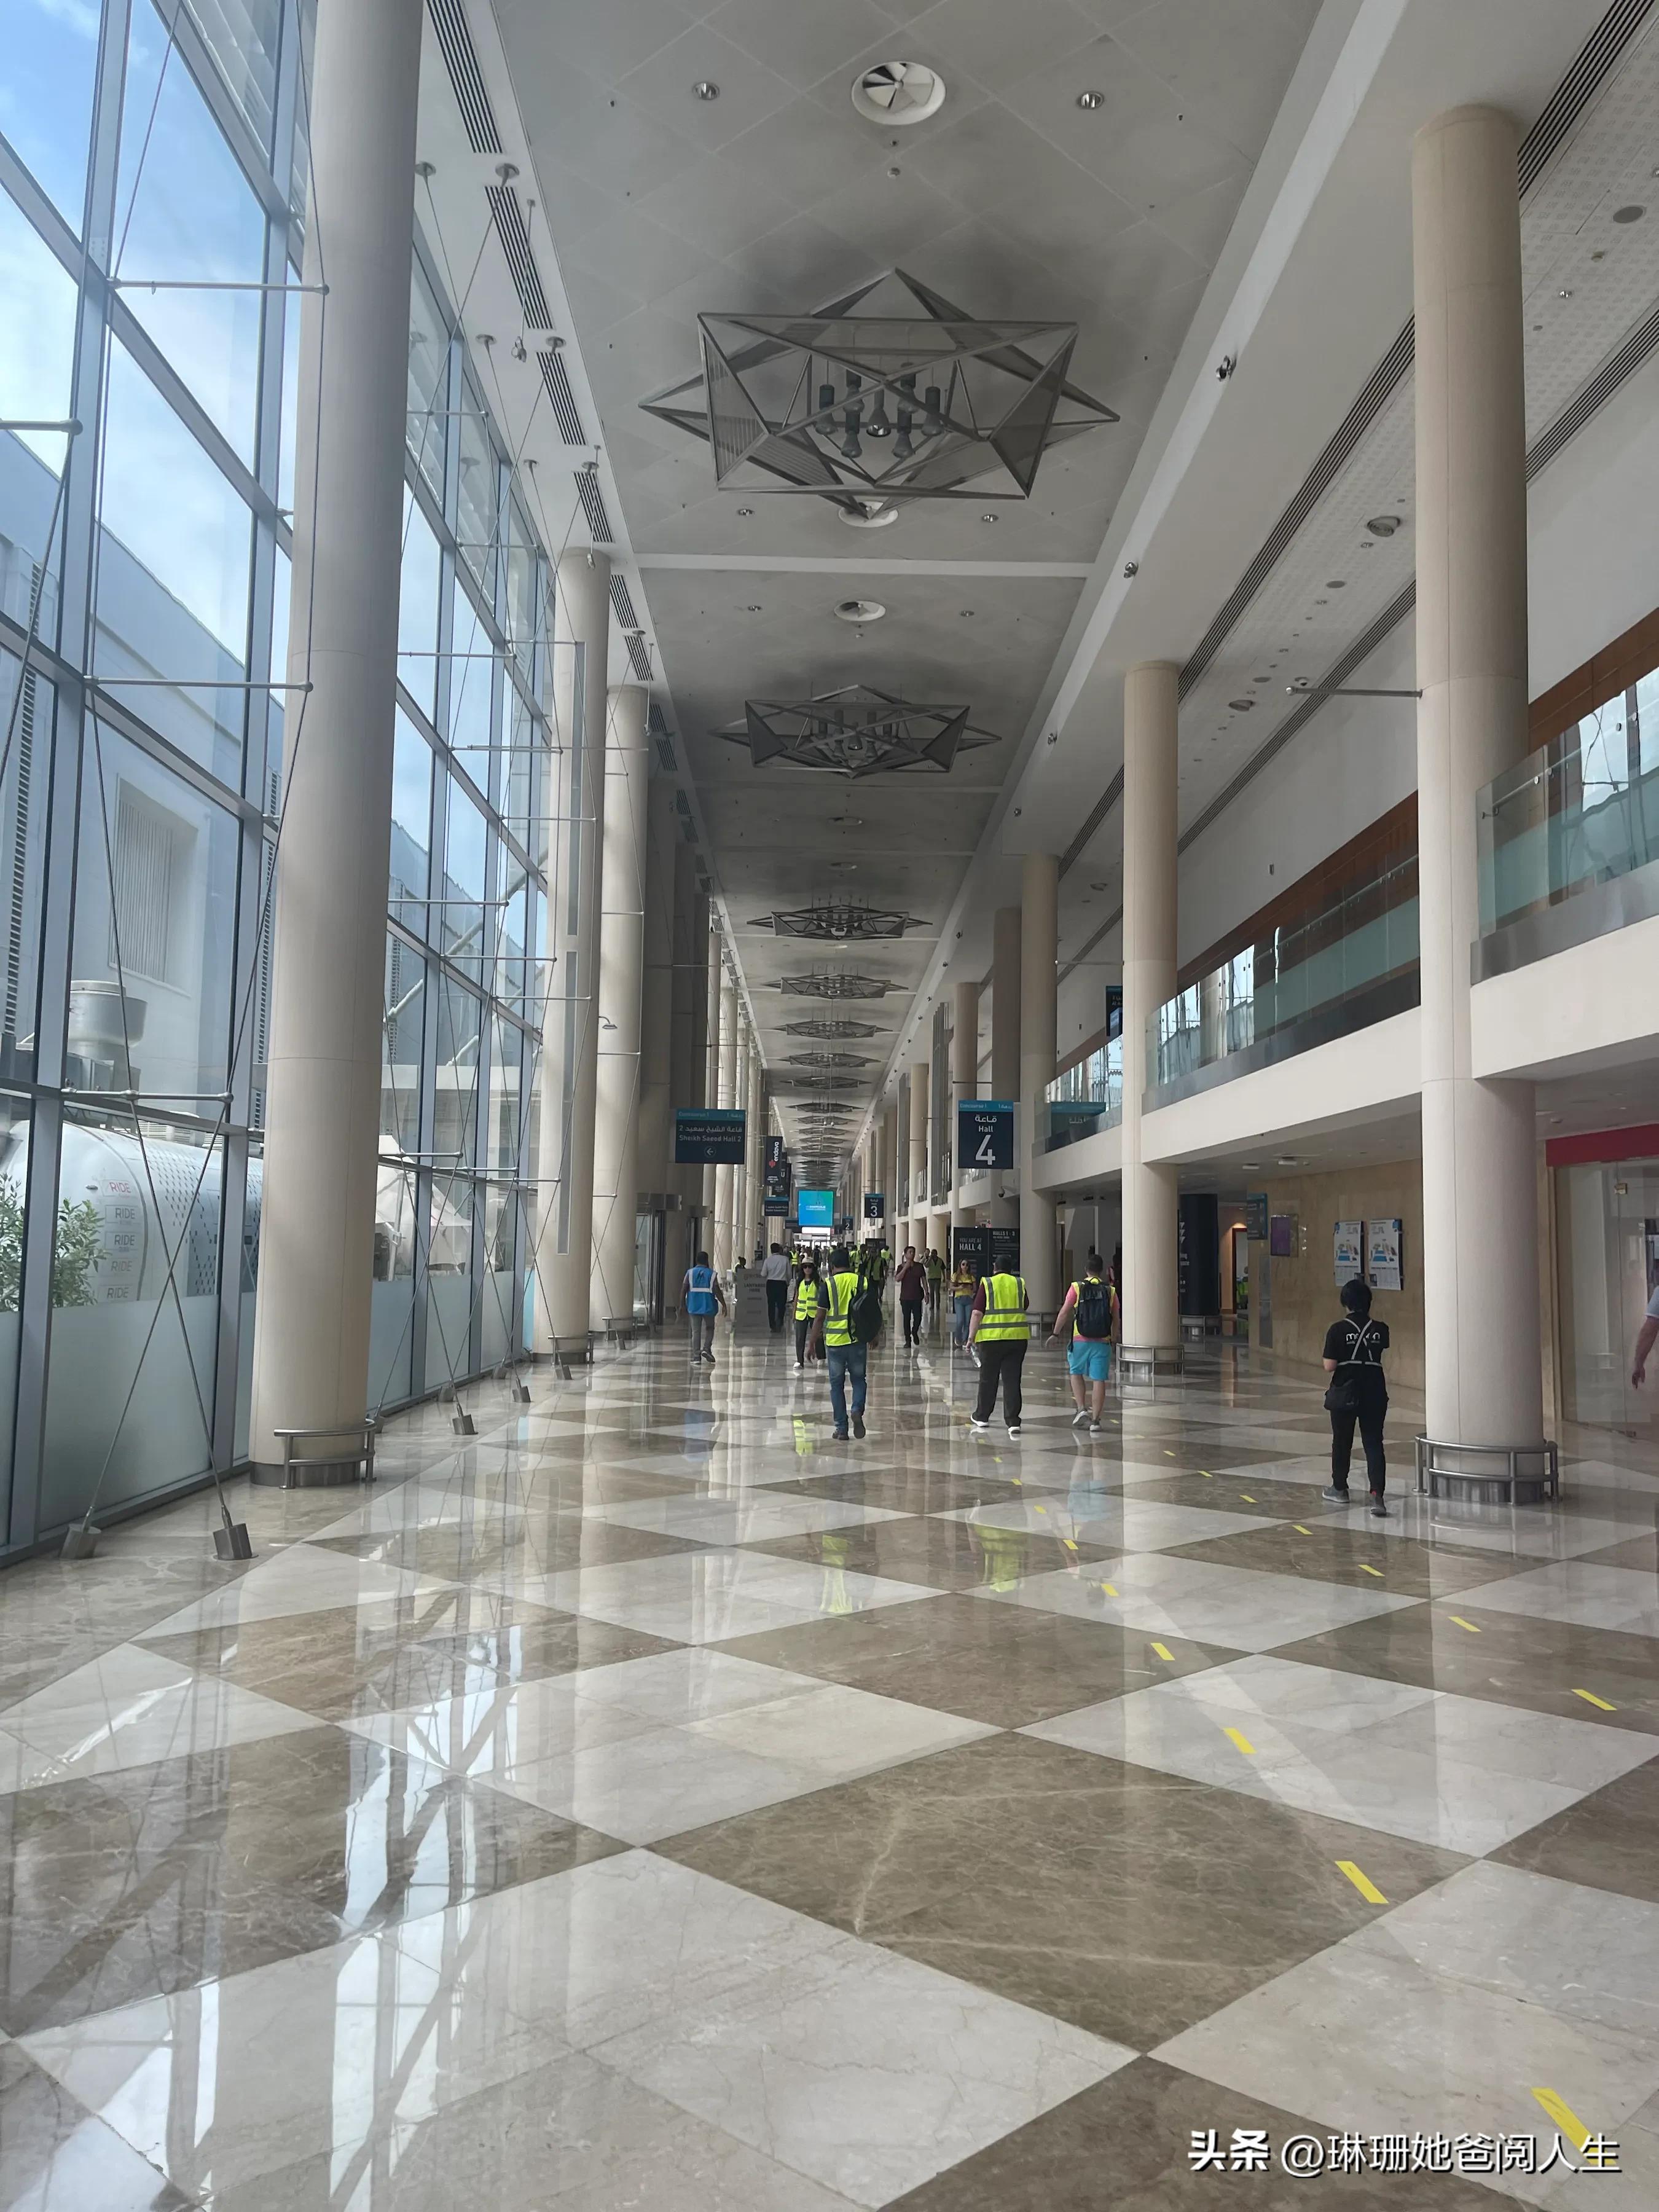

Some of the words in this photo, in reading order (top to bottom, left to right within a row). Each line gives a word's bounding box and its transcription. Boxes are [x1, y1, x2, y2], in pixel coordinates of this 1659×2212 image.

[975, 1114, 997, 1123] قاعة
[975, 1134, 995, 1165] 4
[109, 1182, 131, 1193] RIDE
[115, 1207, 136, 1219] RIDE
[870, 1206, 877, 1217] 3
[114, 1234, 135, 1246] RIDE
[111, 1261, 133, 1272] RIDE
[107, 1287, 129, 1298] RIDE
